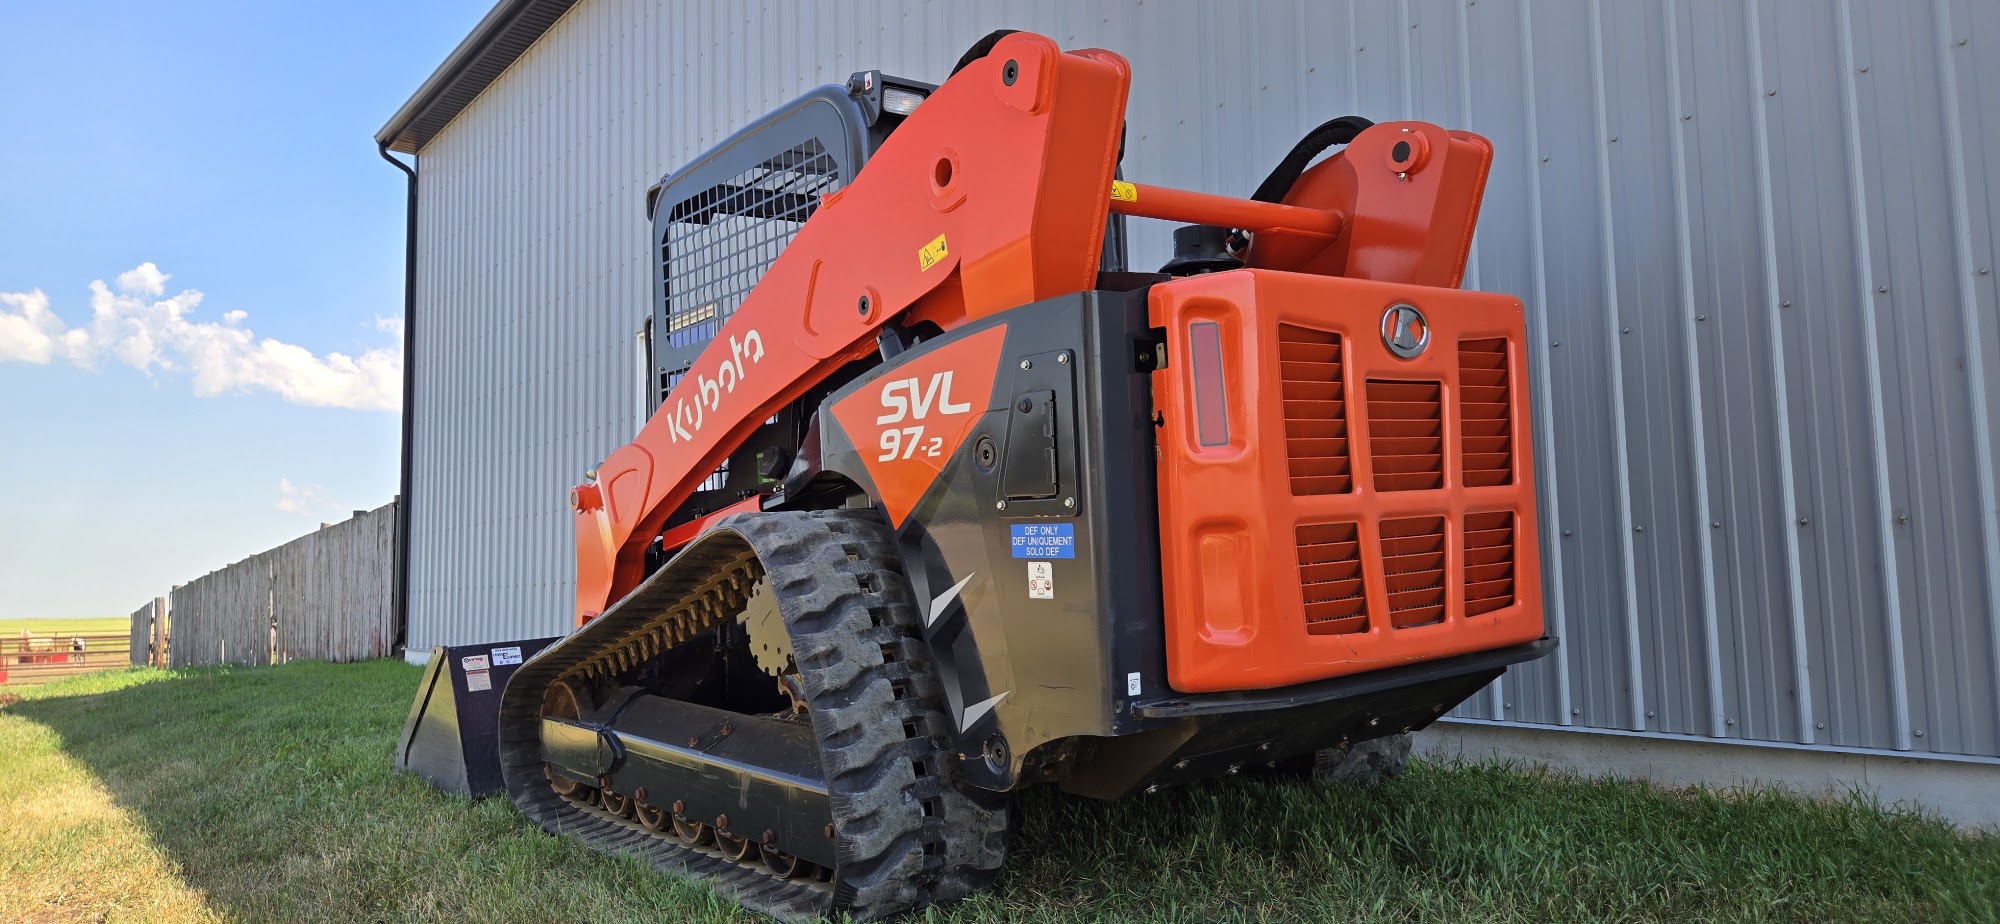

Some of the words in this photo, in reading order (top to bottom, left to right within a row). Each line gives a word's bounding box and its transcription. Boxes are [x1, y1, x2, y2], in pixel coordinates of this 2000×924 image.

[666, 329, 765, 444] Kubota
[876, 370, 971, 425] SVL
[878, 425, 943, 462] 97-2
[1012, 536, 1026, 546] DEF
[1027, 536, 1073, 546] UNIQUEMENT
[1024, 526, 1039, 536] DEF
[1040, 525, 1059, 535] ONLY
[1025, 547, 1044, 556] SOLO
[1045, 546, 1060, 556] DEF
